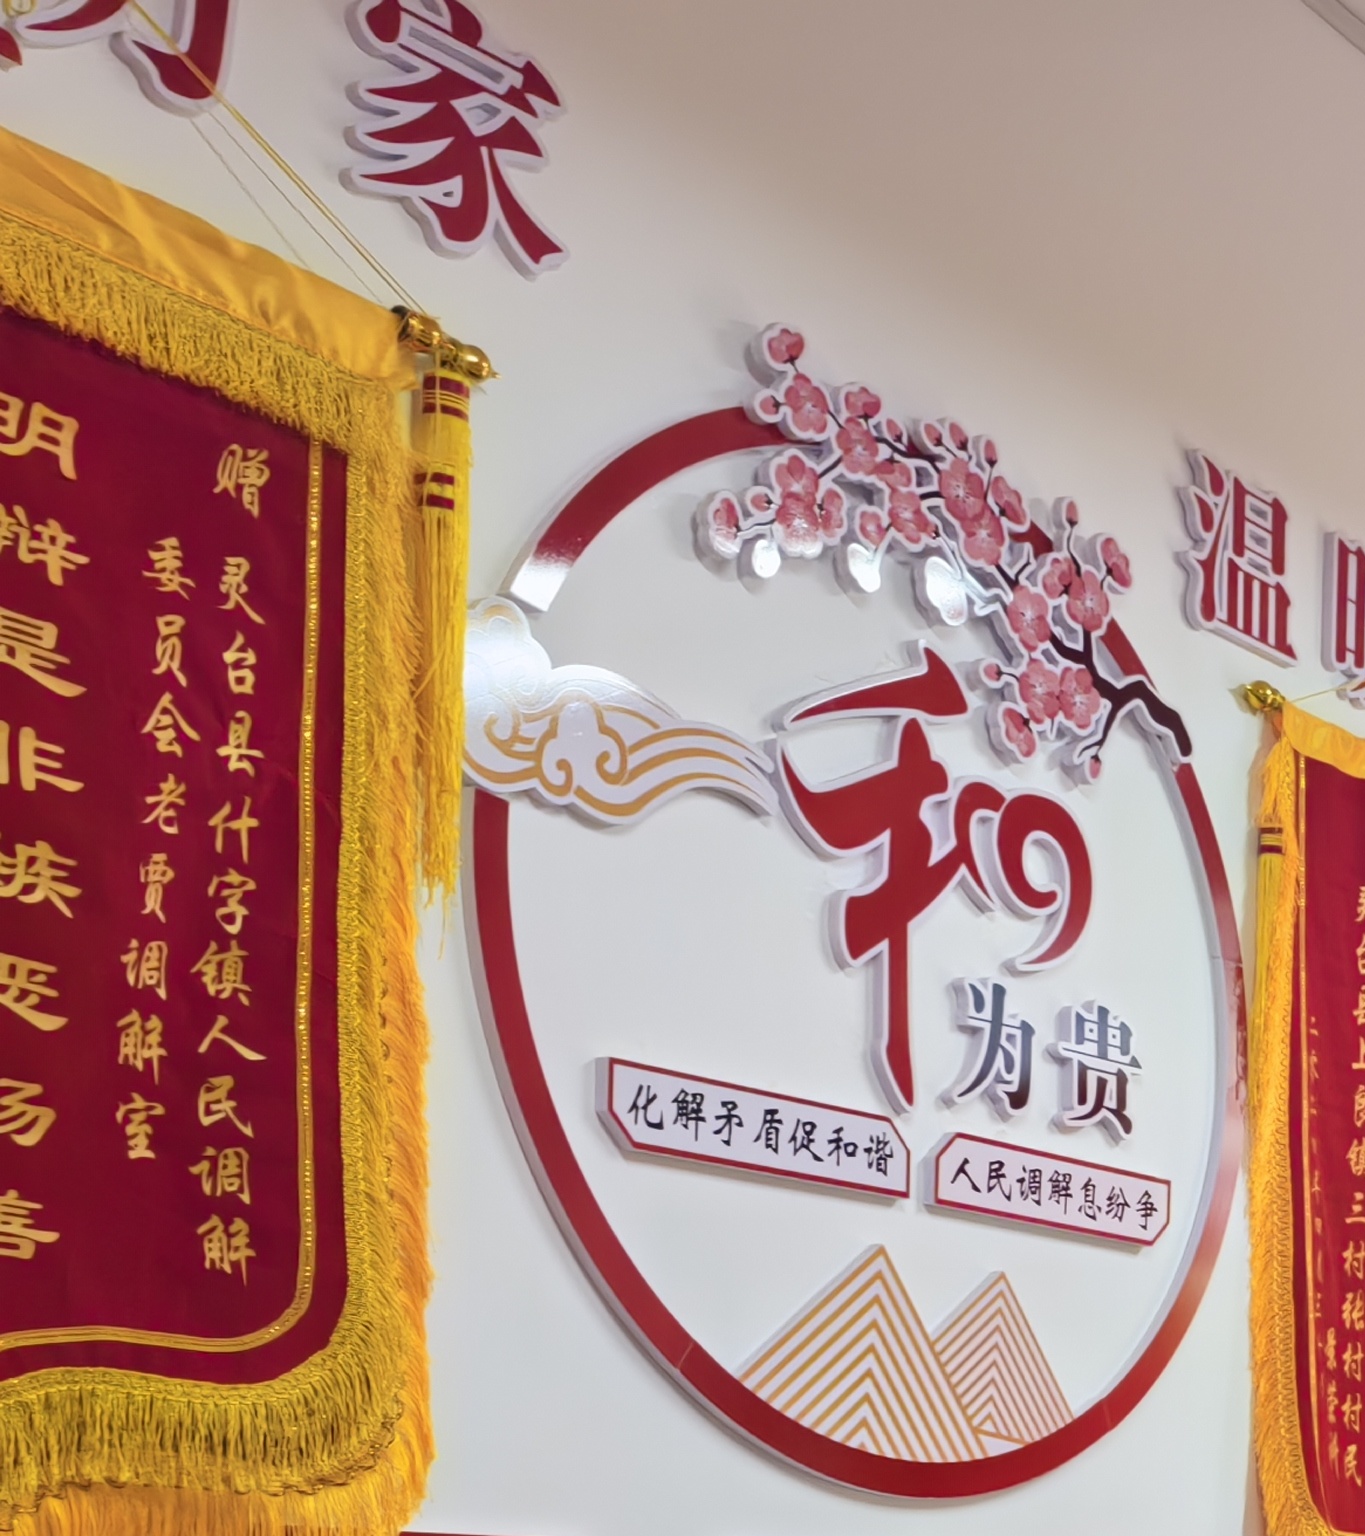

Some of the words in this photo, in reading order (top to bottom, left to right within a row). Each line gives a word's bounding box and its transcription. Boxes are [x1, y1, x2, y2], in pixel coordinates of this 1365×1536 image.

[213, 443, 270, 518] 赠
[115, 537, 201, 1159] 委员会老贾调解室
[189, 556, 267, 1287] 灵台县什字镇人民调解
[779, 646, 1093, 1107] 和
[627, 1084, 895, 1176] 化解矛盾促和谐
[953, 983, 1142, 1136] 为贵
[950, 1156, 1159, 1230] 人民调解息纷争
